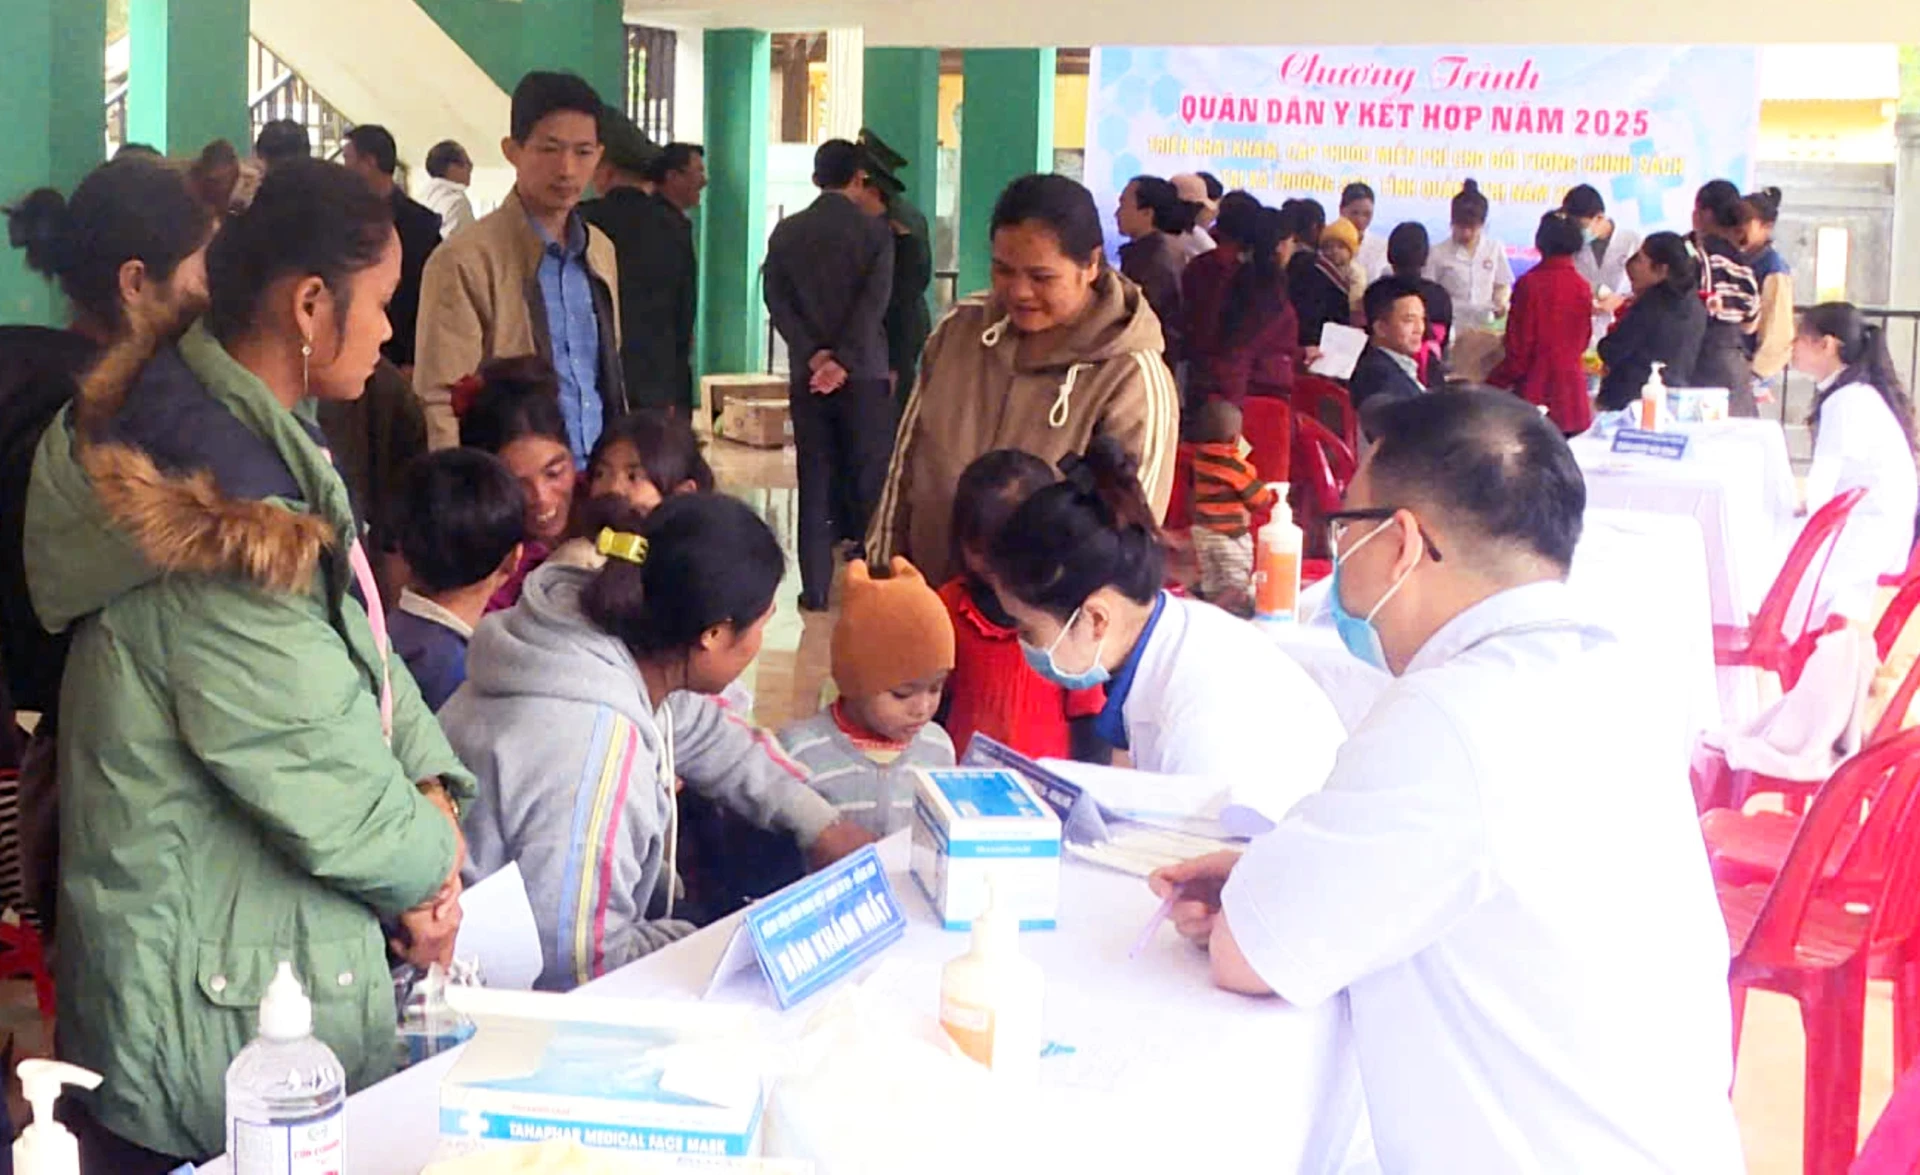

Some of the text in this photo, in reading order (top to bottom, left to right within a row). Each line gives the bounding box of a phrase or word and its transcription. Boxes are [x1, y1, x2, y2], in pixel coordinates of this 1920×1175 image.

[1281, 51, 1540, 95] Chương Trình
[1181, 92, 1259, 125] QUÂN
[1266, 96, 1325, 125] DÂN
[1334, 101, 1350, 126] Y
[1359, 92, 1415, 129] KẾT
[1490, 100, 1564, 134] NĂM
[1574, 109, 1649, 137] 2025
[777, 940, 819, 983] BÀN
[810, 914, 863, 962] KHÁM
[584, 1127, 646, 1150] MEDICAL
[649, 1134, 684, 1153] FACE
[687, 1137, 727, 1156] MASK
